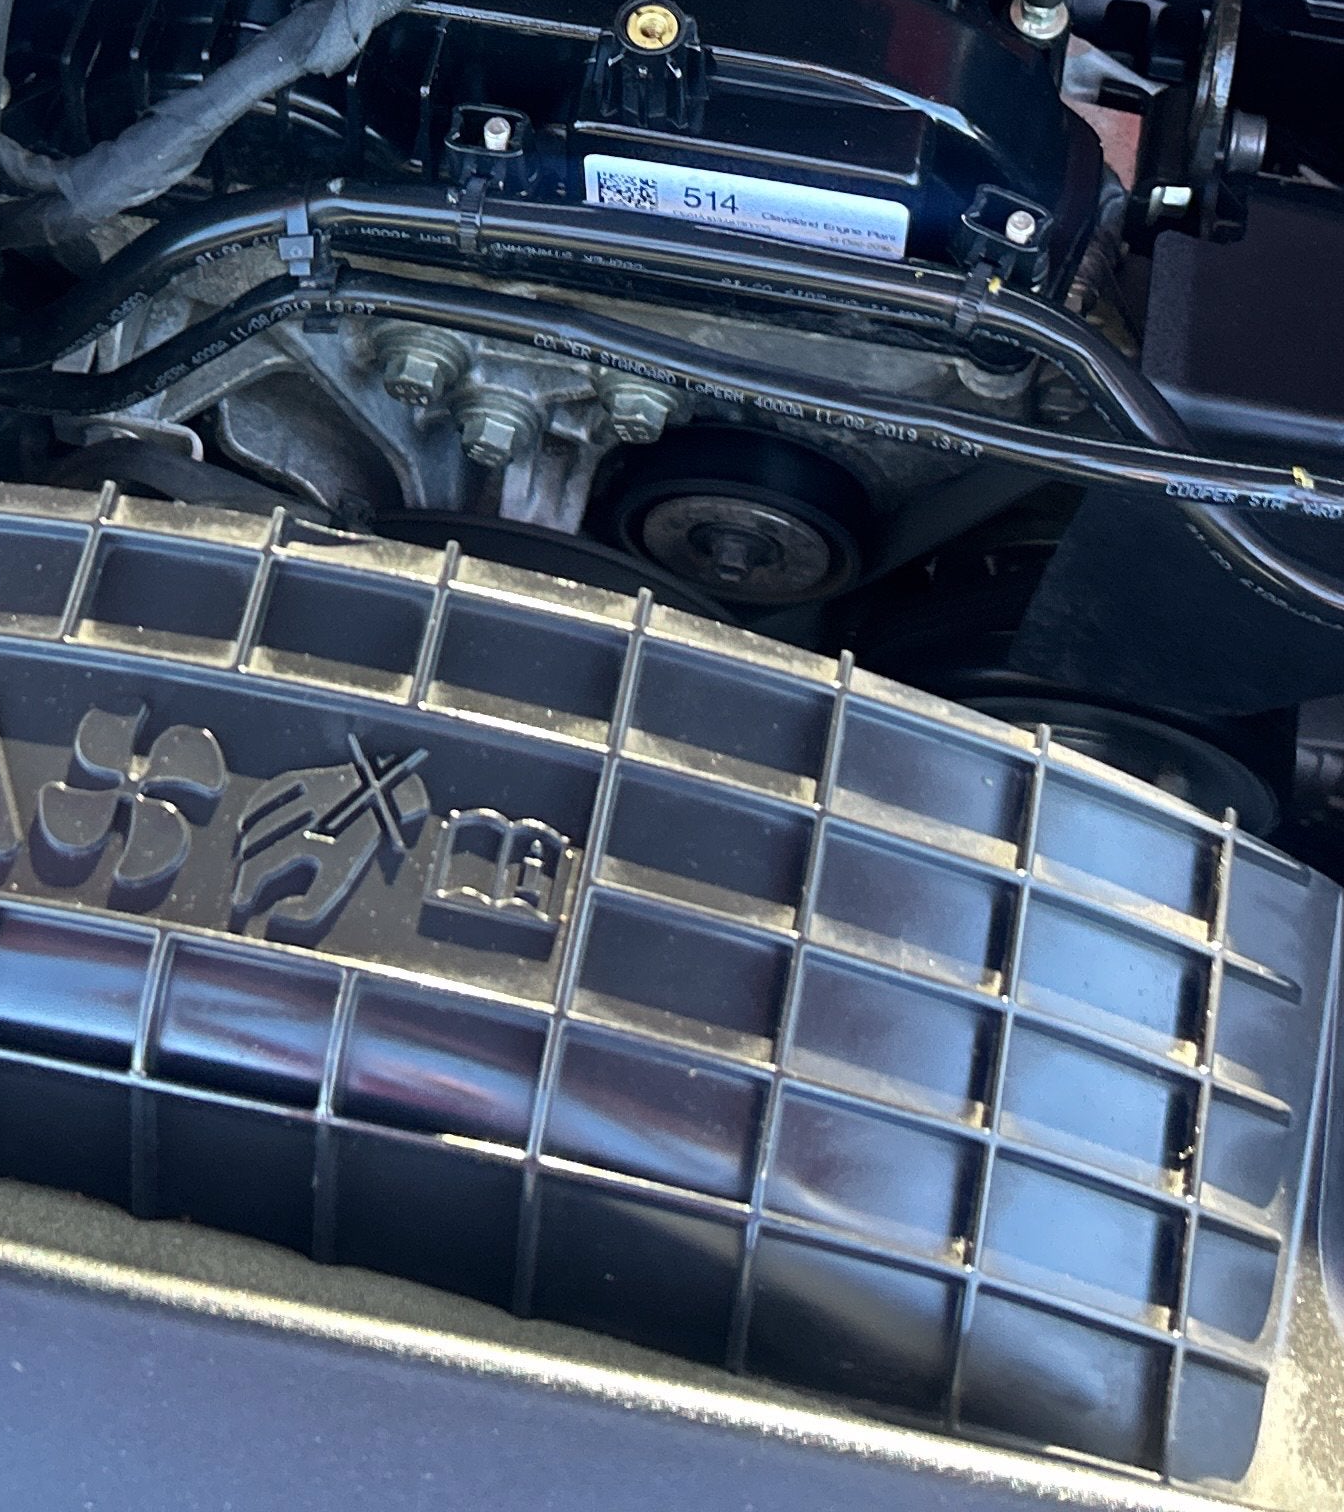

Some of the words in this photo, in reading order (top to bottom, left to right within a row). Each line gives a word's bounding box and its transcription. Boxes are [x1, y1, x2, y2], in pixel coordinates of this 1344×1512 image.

[683, 186, 739, 215] 514
[761, 211, 818, 230] Cleveland
[822, 222, 862, 238] Engine
[866, 229, 897, 242] Plant
[533, 333, 592, 360] COER
[598, 351, 677, 386] STANDARD
[753, 397, 804, 419] 4000A
[814, 407, 918, 442] 11/08/2019
[1164, 481, 1240, 504] COOPER
